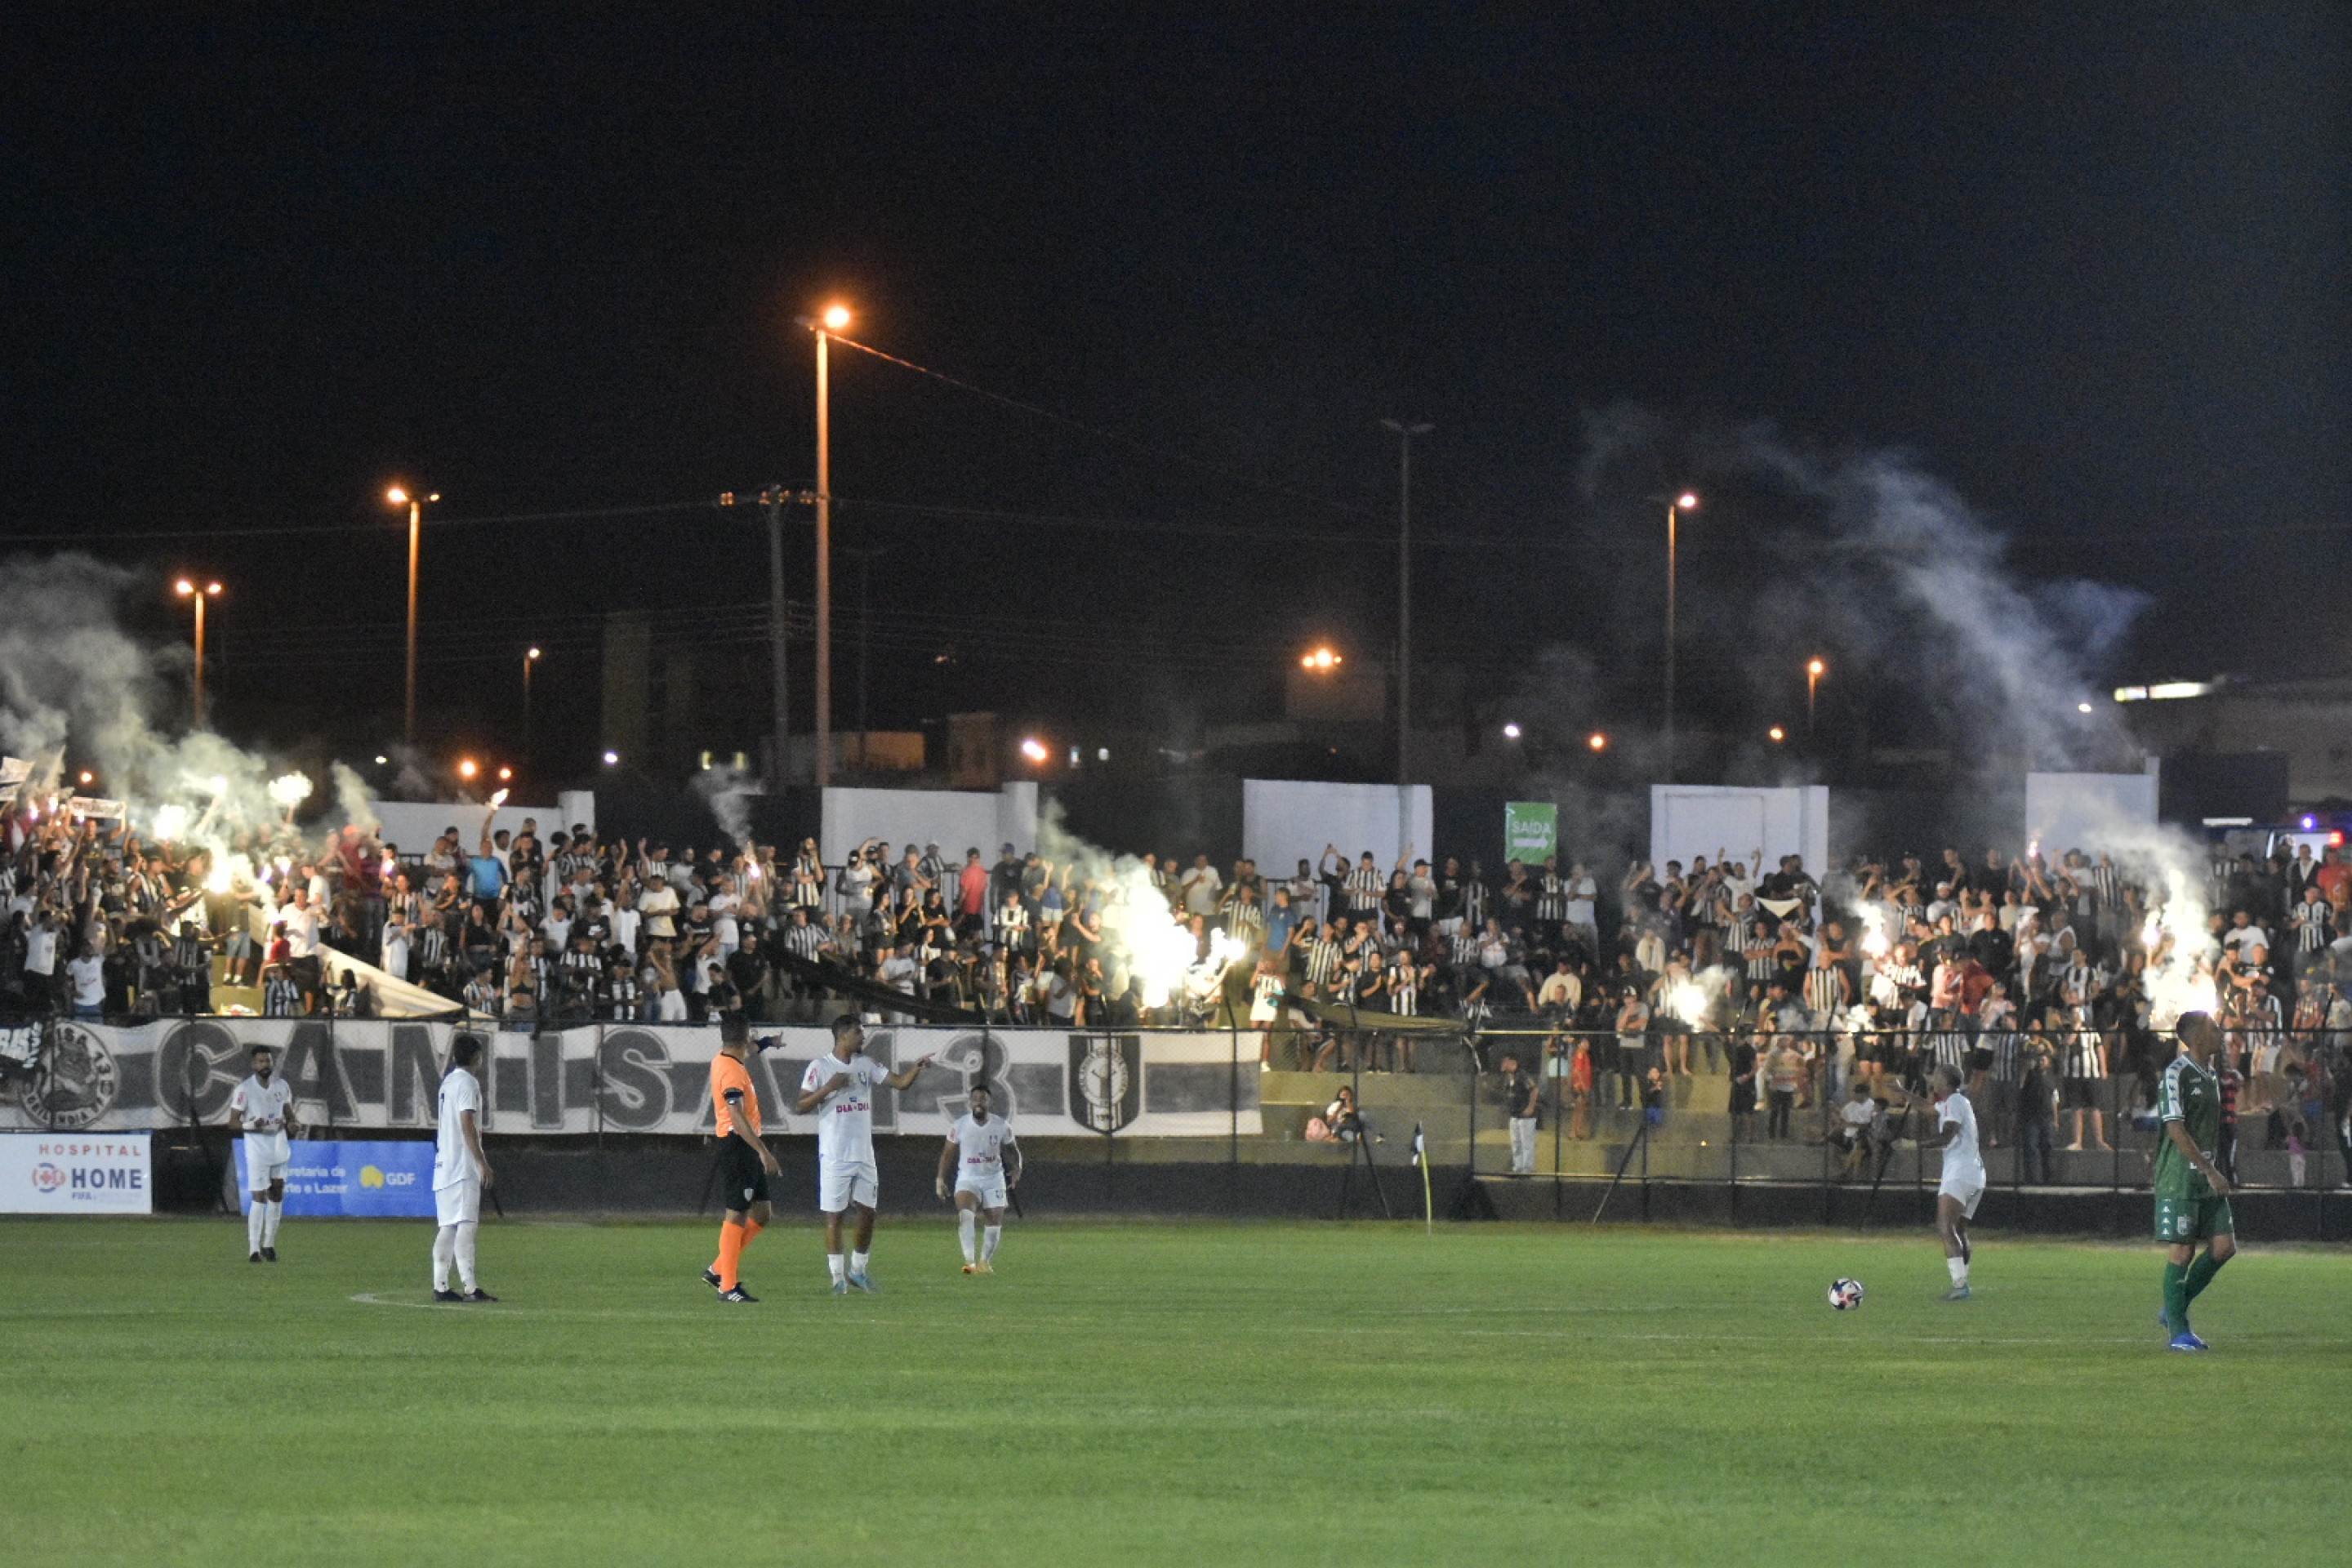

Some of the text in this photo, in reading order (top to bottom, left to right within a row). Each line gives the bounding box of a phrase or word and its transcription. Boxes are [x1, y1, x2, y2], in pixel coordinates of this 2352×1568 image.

[38, 1144, 141, 1156] HOSPITAL
[71, 1168, 142, 1189] HOME
[385, 1173, 416, 1185] GDF
[314, 1182, 348, 1194] Lazer
